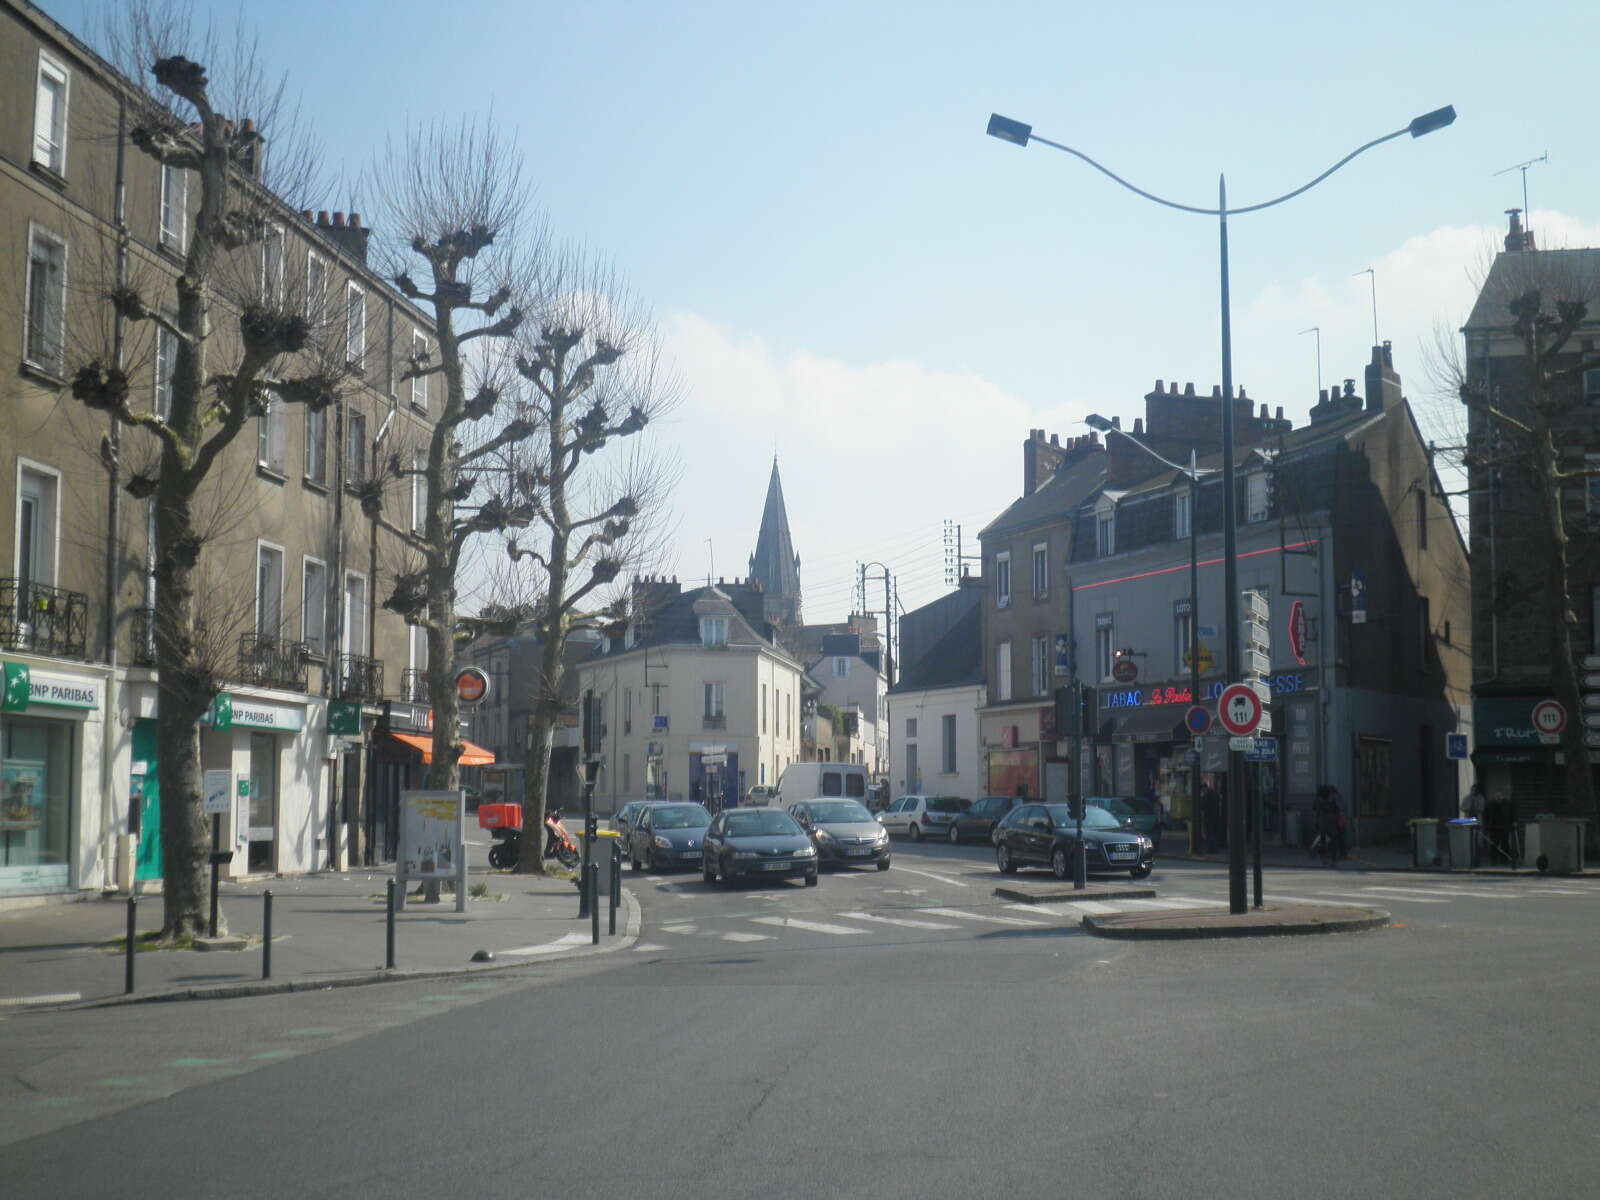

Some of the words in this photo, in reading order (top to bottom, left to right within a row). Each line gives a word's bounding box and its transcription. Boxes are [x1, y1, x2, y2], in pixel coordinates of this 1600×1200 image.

[28, 683, 49, 697] BNP
[51, 686, 94, 703] PARIBAS
[1105, 689, 1142, 707] TABAC
[245, 711, 274, 724] PARIBAS
